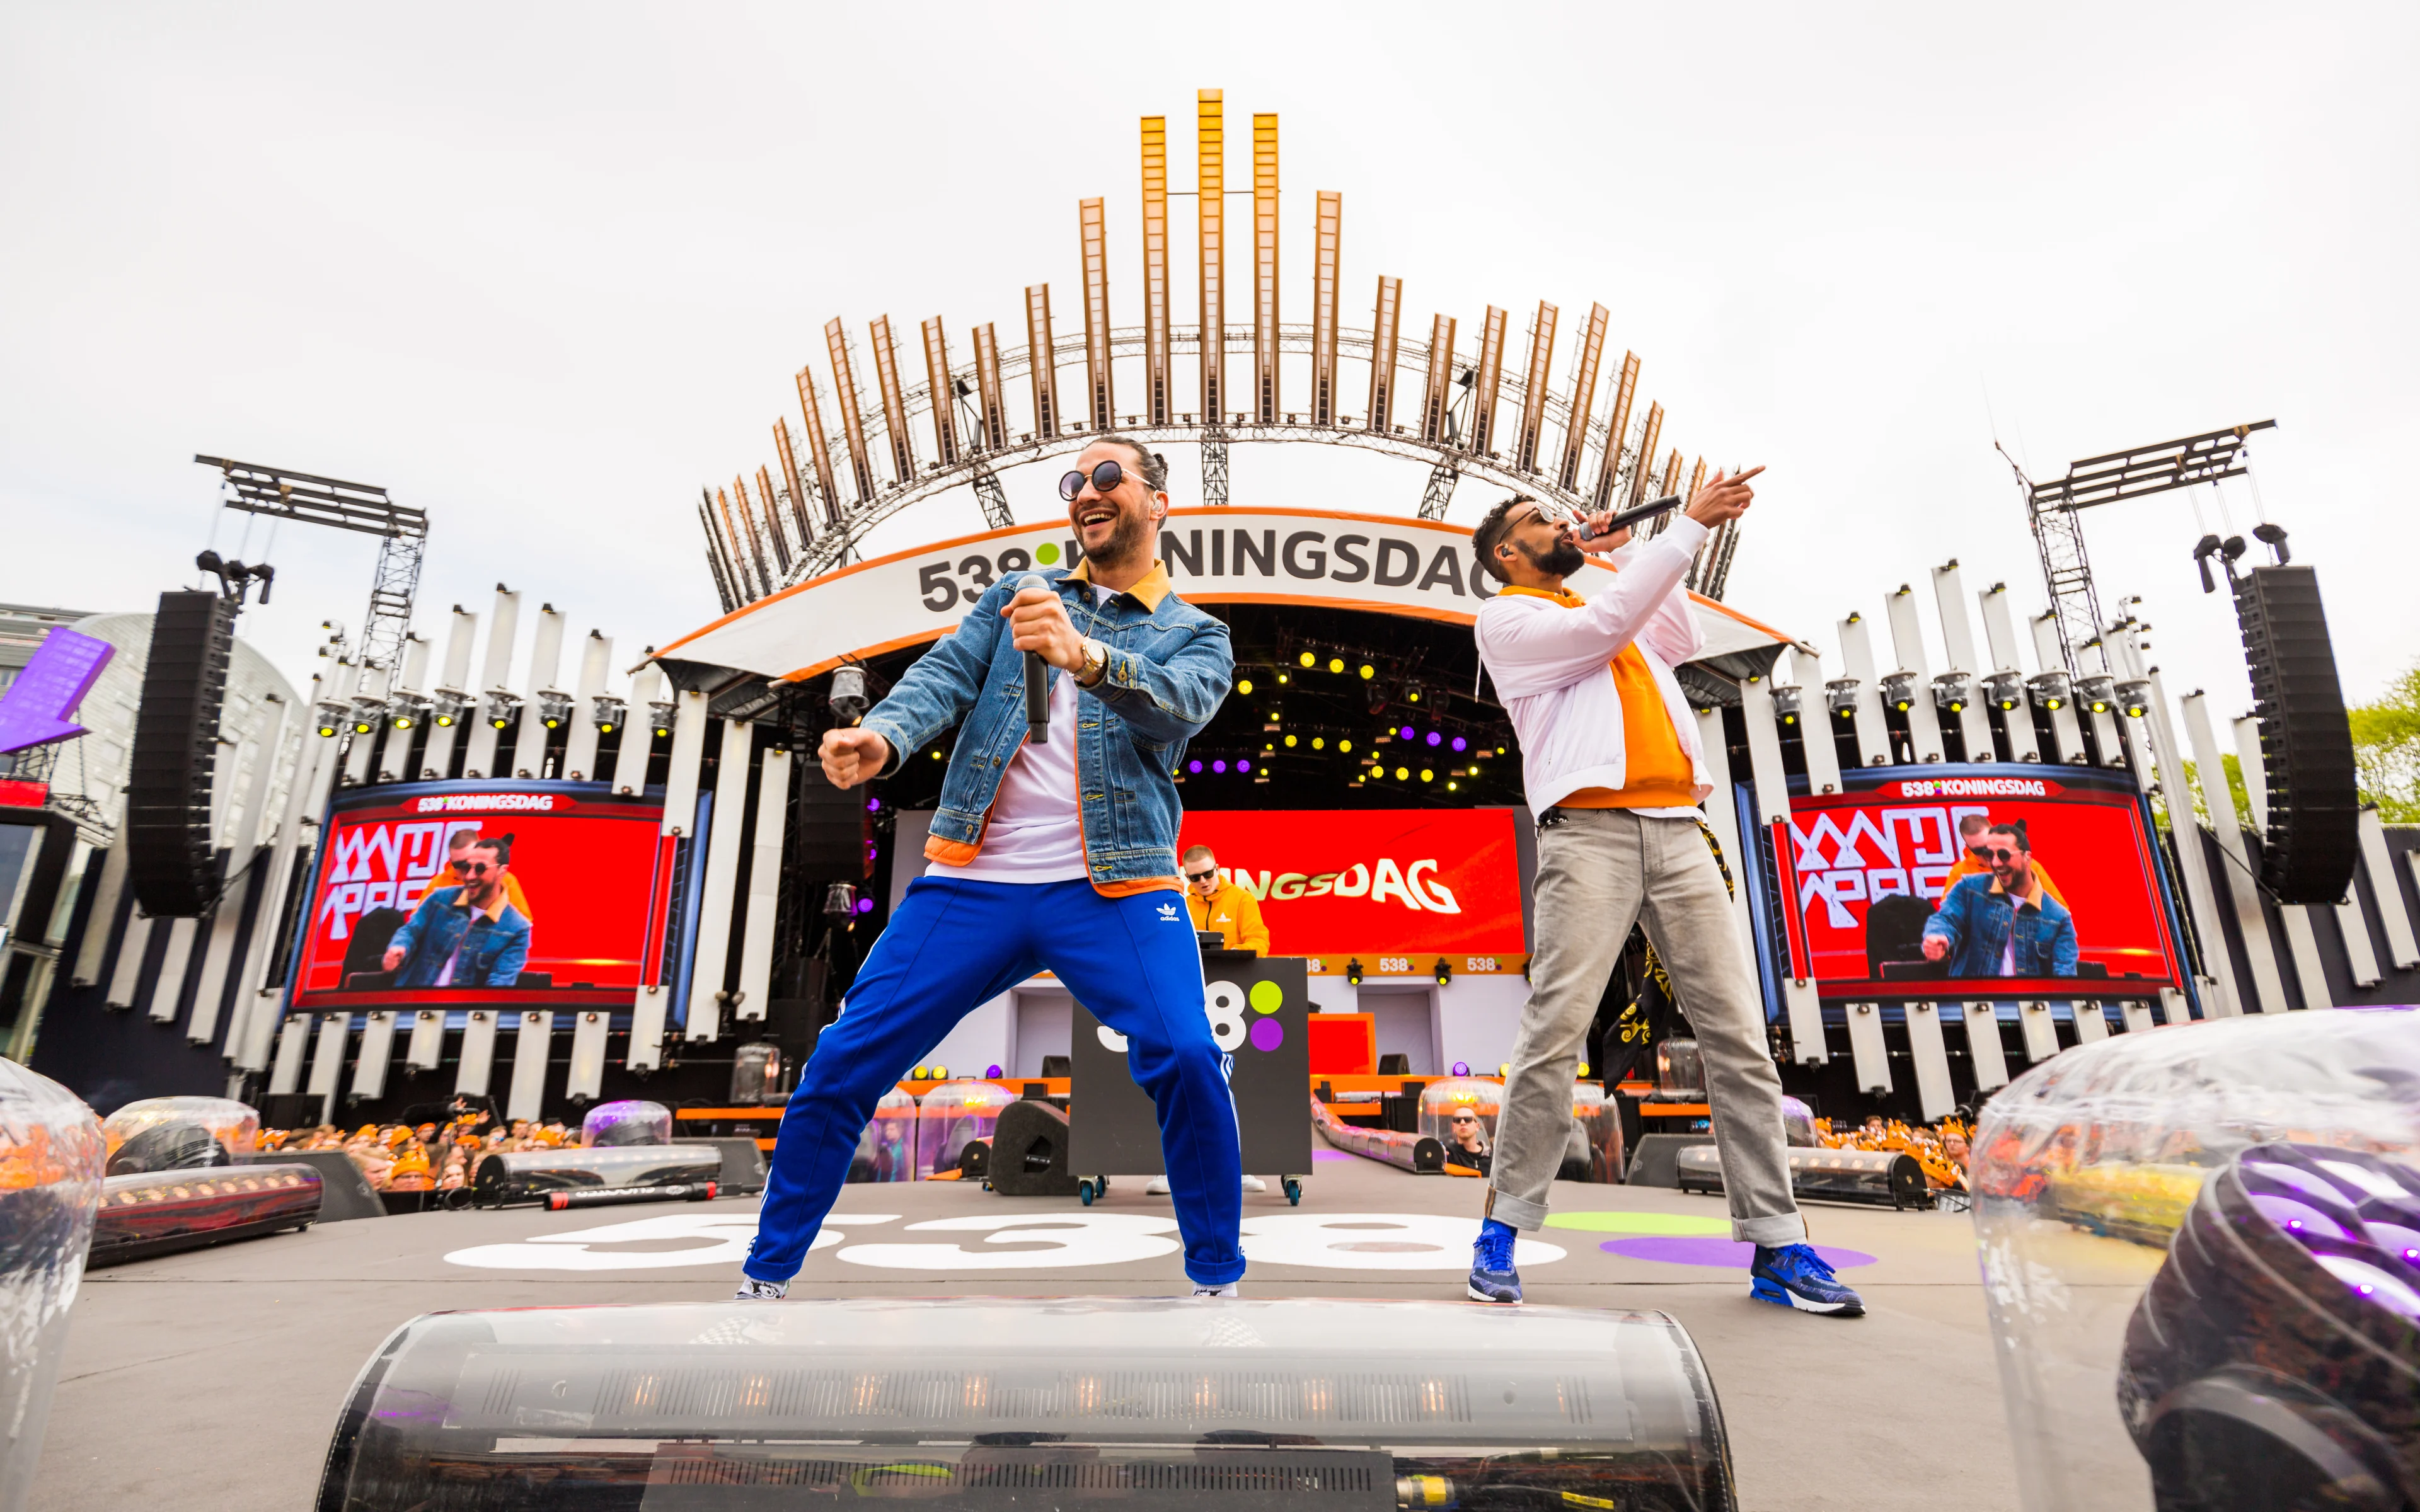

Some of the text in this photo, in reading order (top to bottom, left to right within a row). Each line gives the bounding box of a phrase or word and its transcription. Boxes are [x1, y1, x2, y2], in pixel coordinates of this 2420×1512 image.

[1901, 779, 2046, 798] 538 KONINGSDAG
[446, 794, 553, 811] KONINGSDAG
[1380, 958, 1408, 972] 538
[1466, 957, 1496, 971] 538
[442, 1212, 1567, 1271] 538
